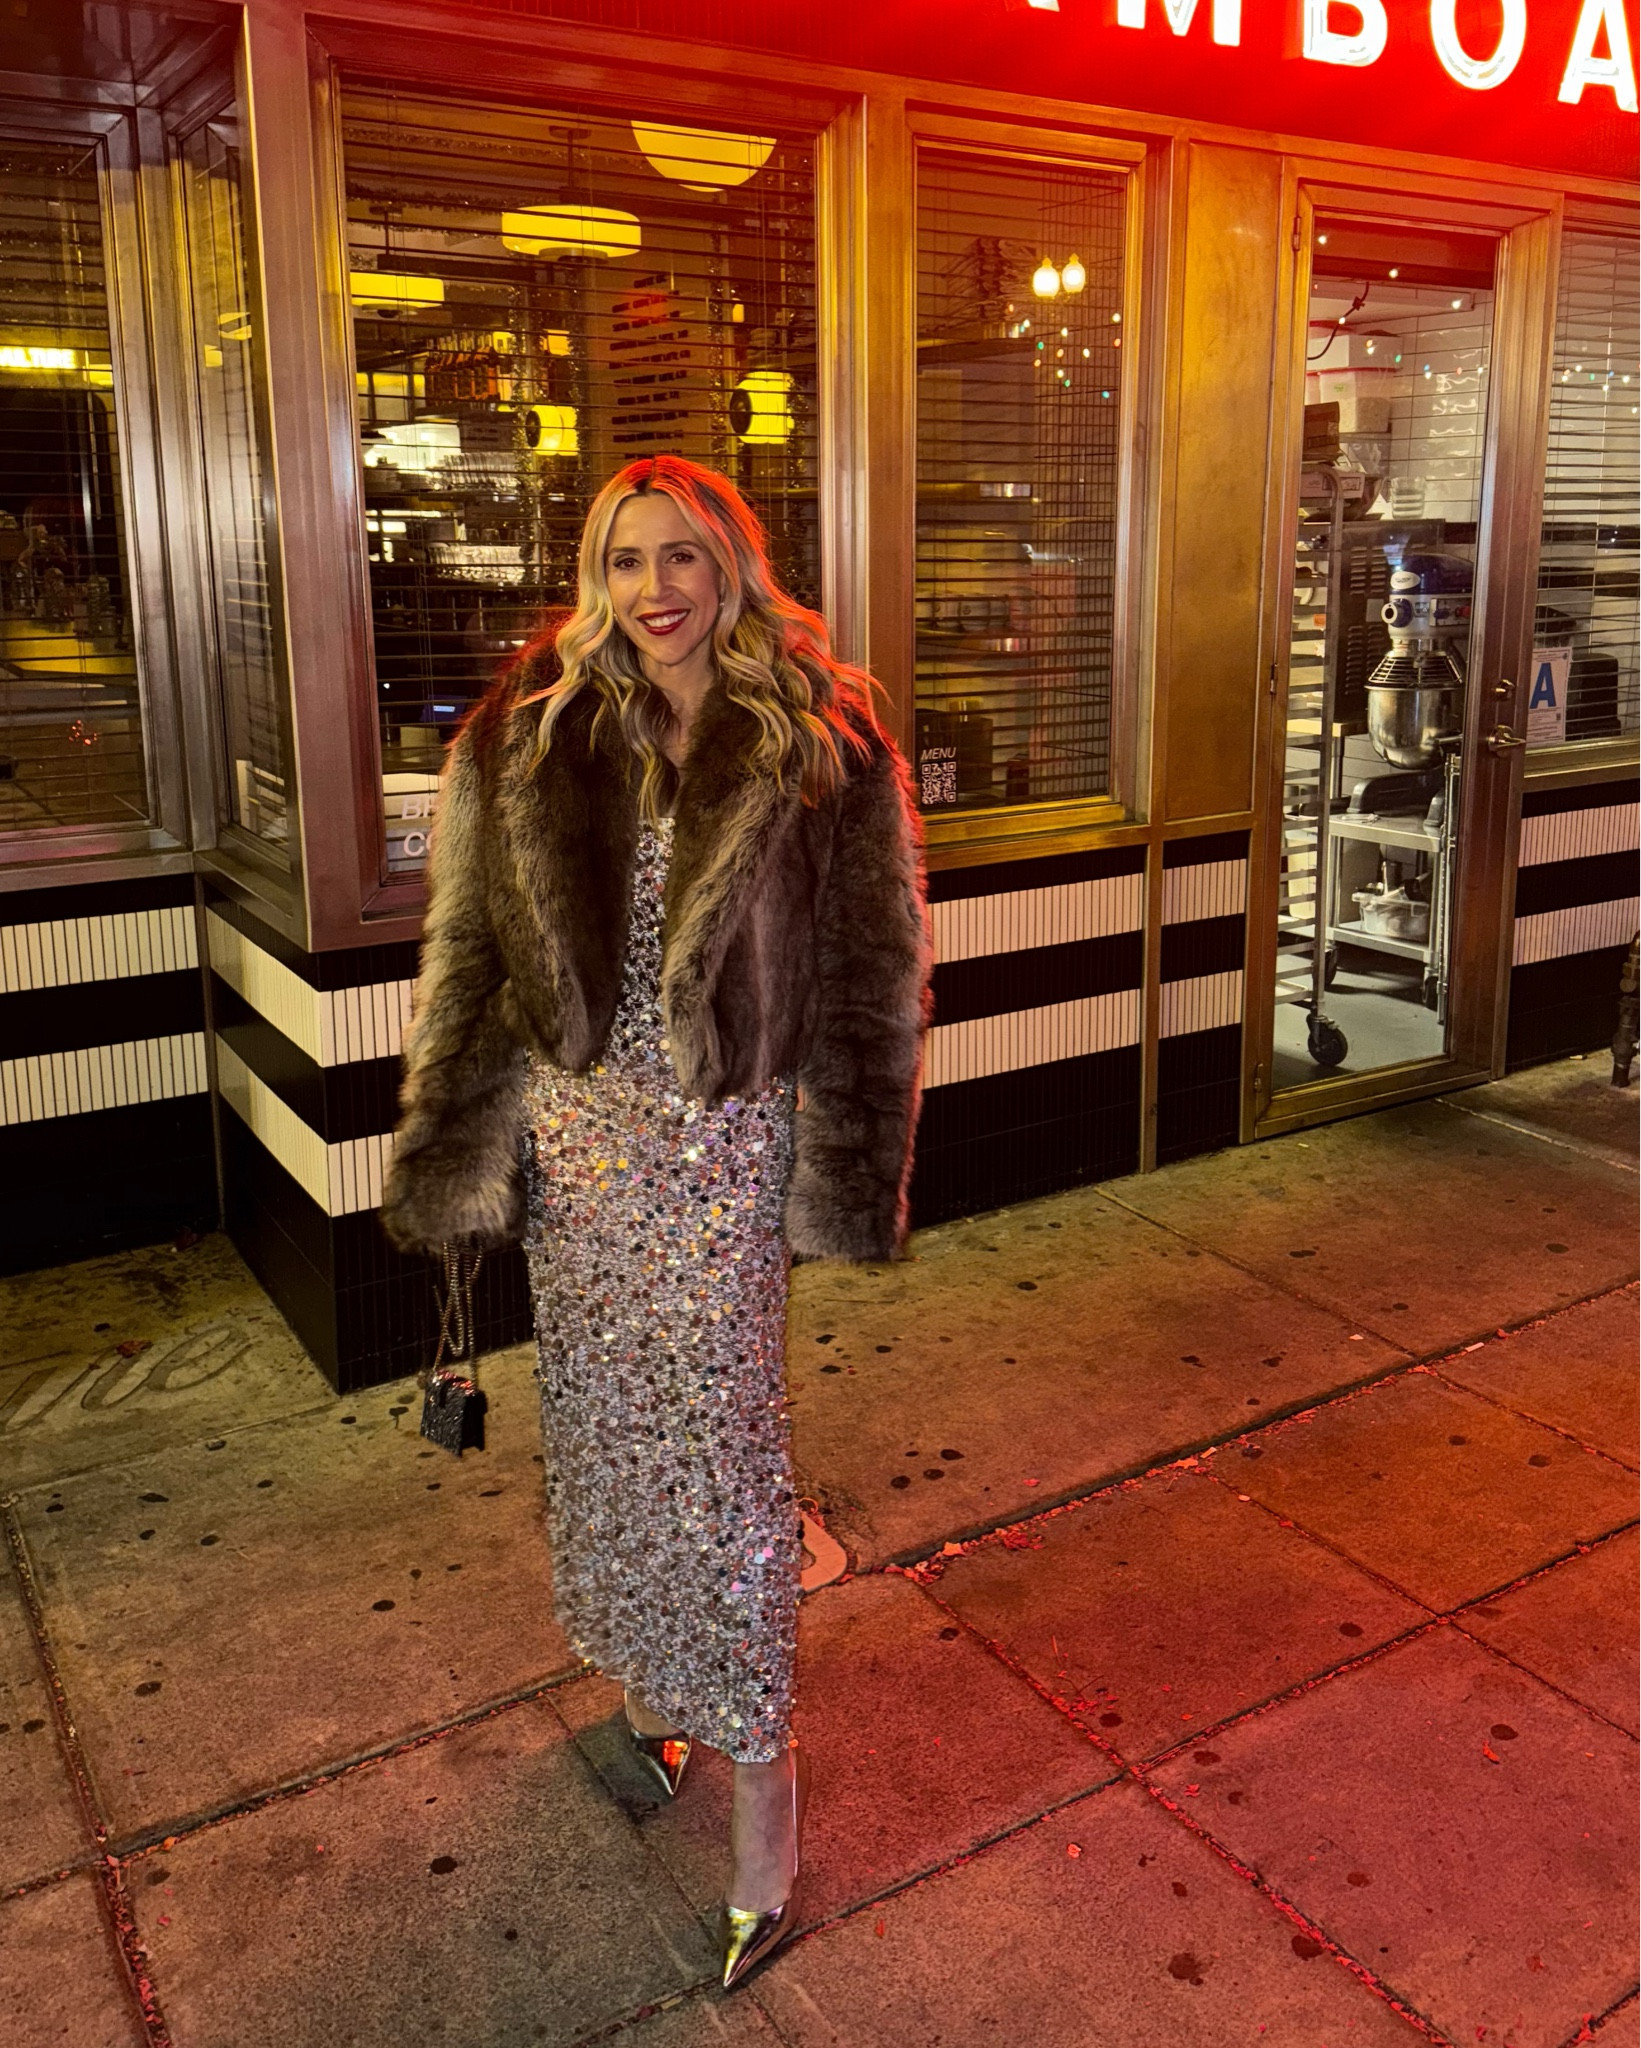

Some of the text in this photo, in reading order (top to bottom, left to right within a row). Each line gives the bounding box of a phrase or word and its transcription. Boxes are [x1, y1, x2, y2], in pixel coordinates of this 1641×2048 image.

[1028, 0, 1638, 113] BOA
[1530, 662, 1557, 709] A
[921, 747, 957, 760] MENU
